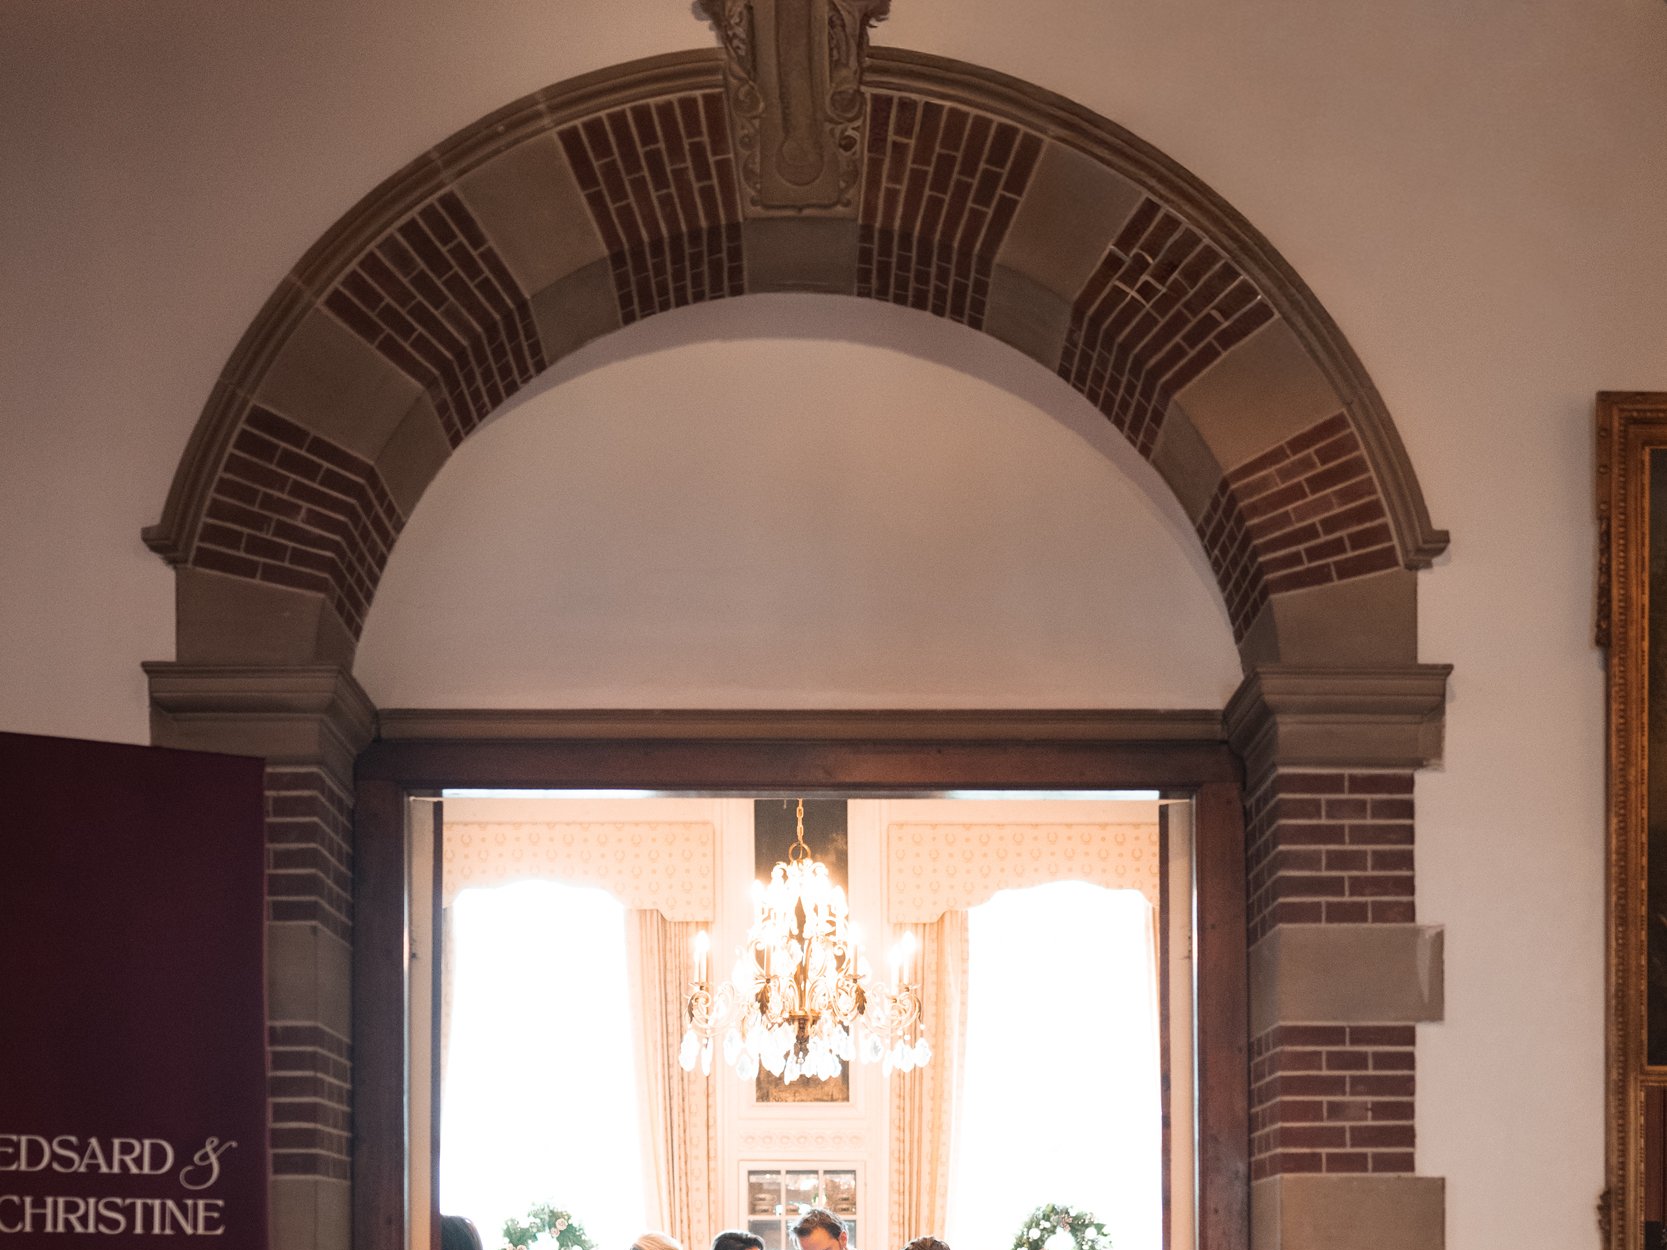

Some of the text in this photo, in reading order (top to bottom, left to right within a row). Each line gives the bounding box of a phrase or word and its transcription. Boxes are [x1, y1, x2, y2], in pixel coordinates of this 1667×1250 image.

[0, 1134, 238, 1190] EDSARD &
[0, 1194, 226, 1236] CHRISTINE
